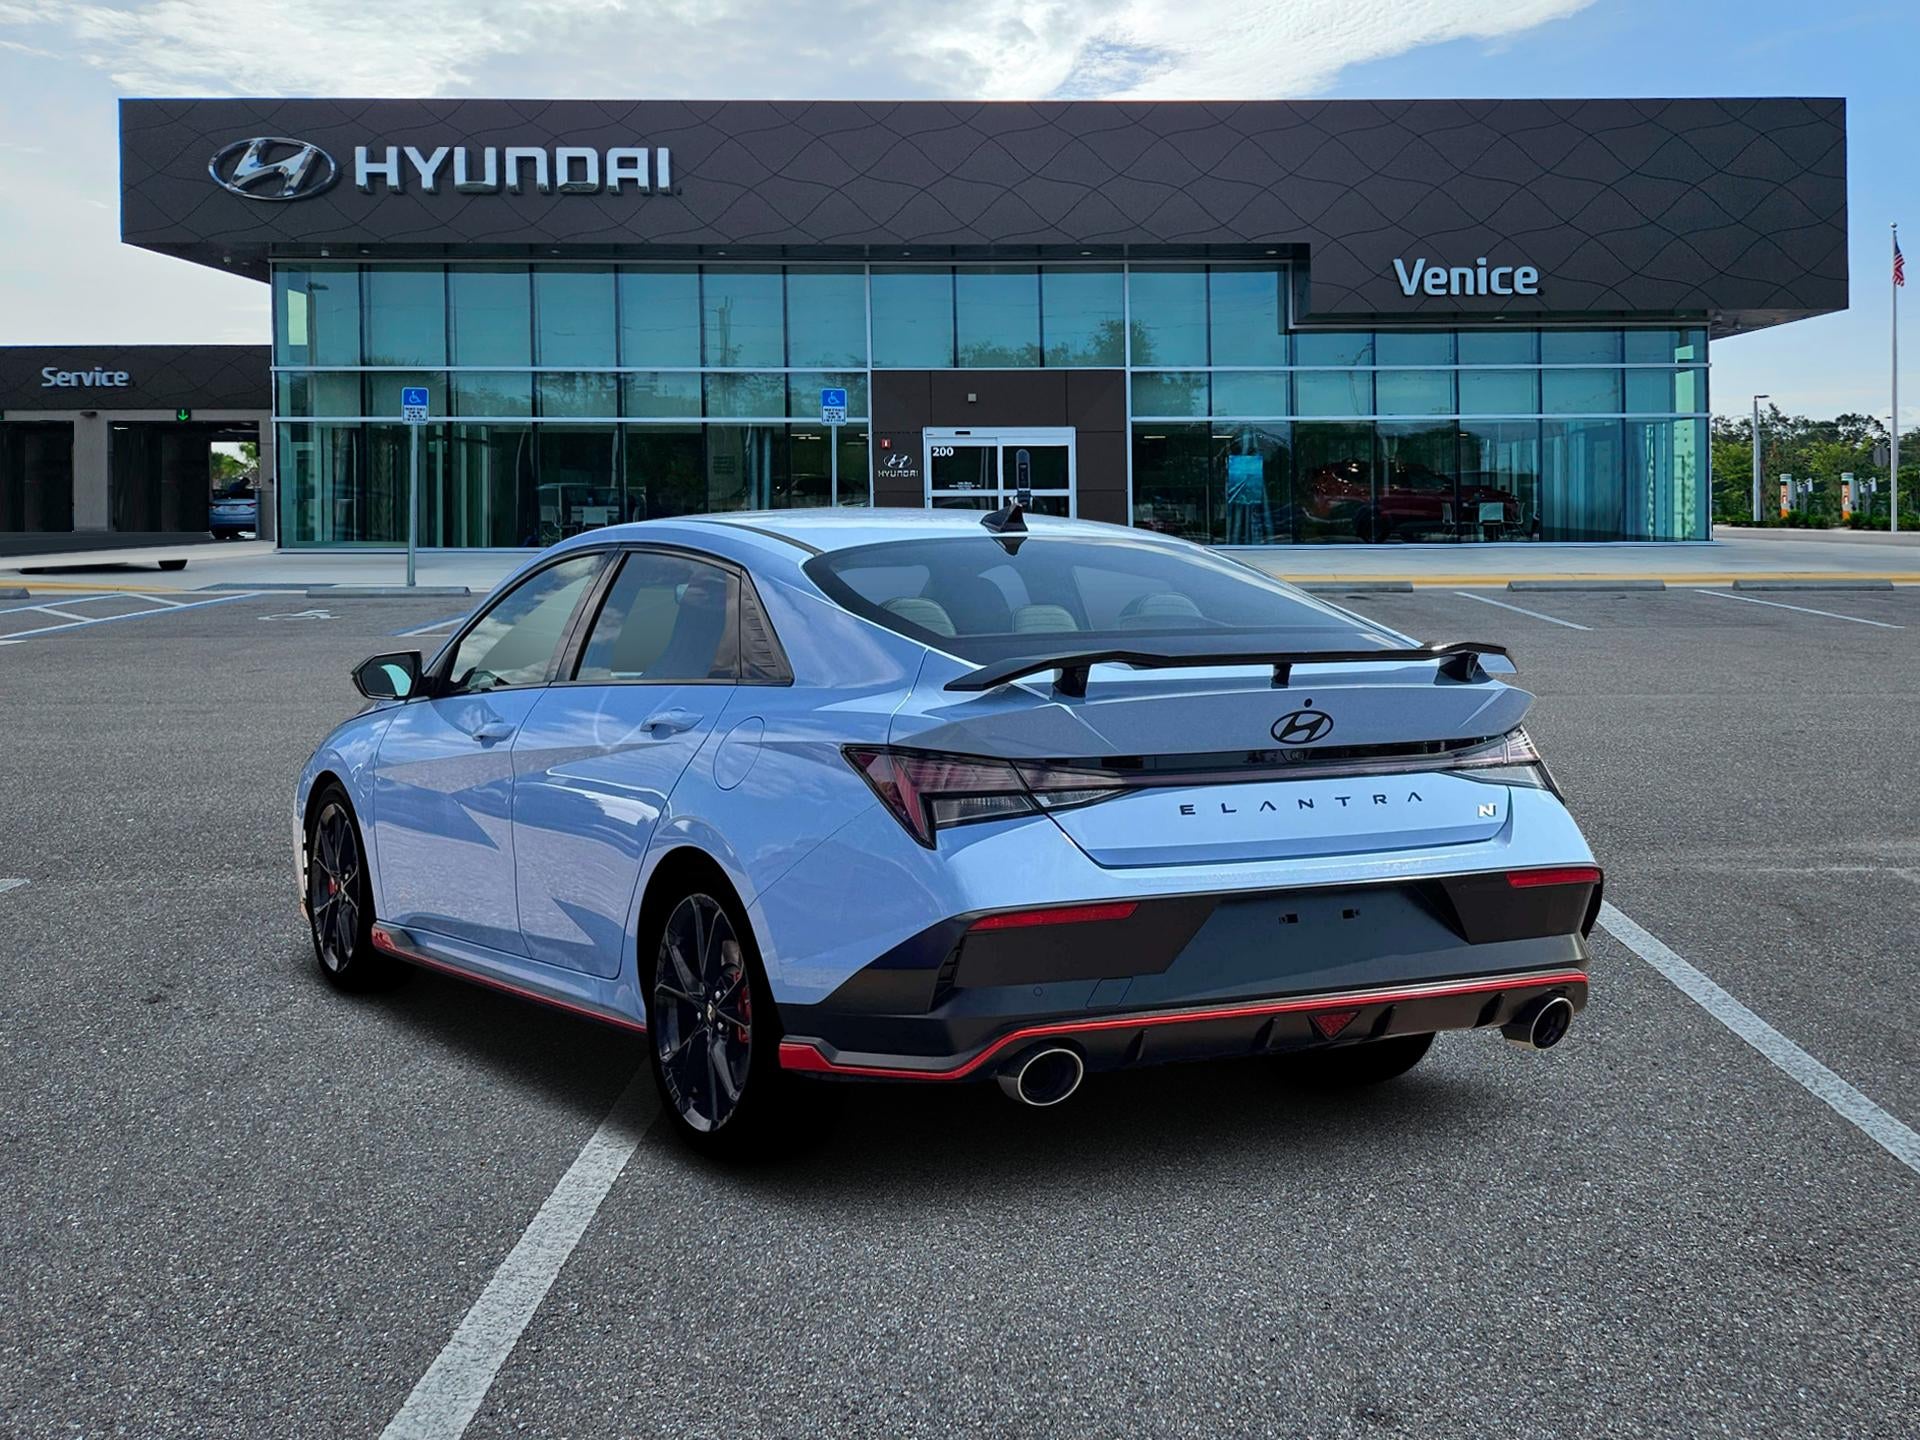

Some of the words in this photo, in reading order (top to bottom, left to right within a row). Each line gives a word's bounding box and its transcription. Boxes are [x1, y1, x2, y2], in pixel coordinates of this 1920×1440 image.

[354, 145, 673, 195] HYUNDAI
[1392, 256, 1539, 296] Venice
[41, 366, 130, 388] Service
[932, 446, 954, 457] 200
[877, 470, 919, 478] HYUNDAI
[1179, 791, 1423, 816] ELANTRA
[1477, 803, 1497, 818] N
